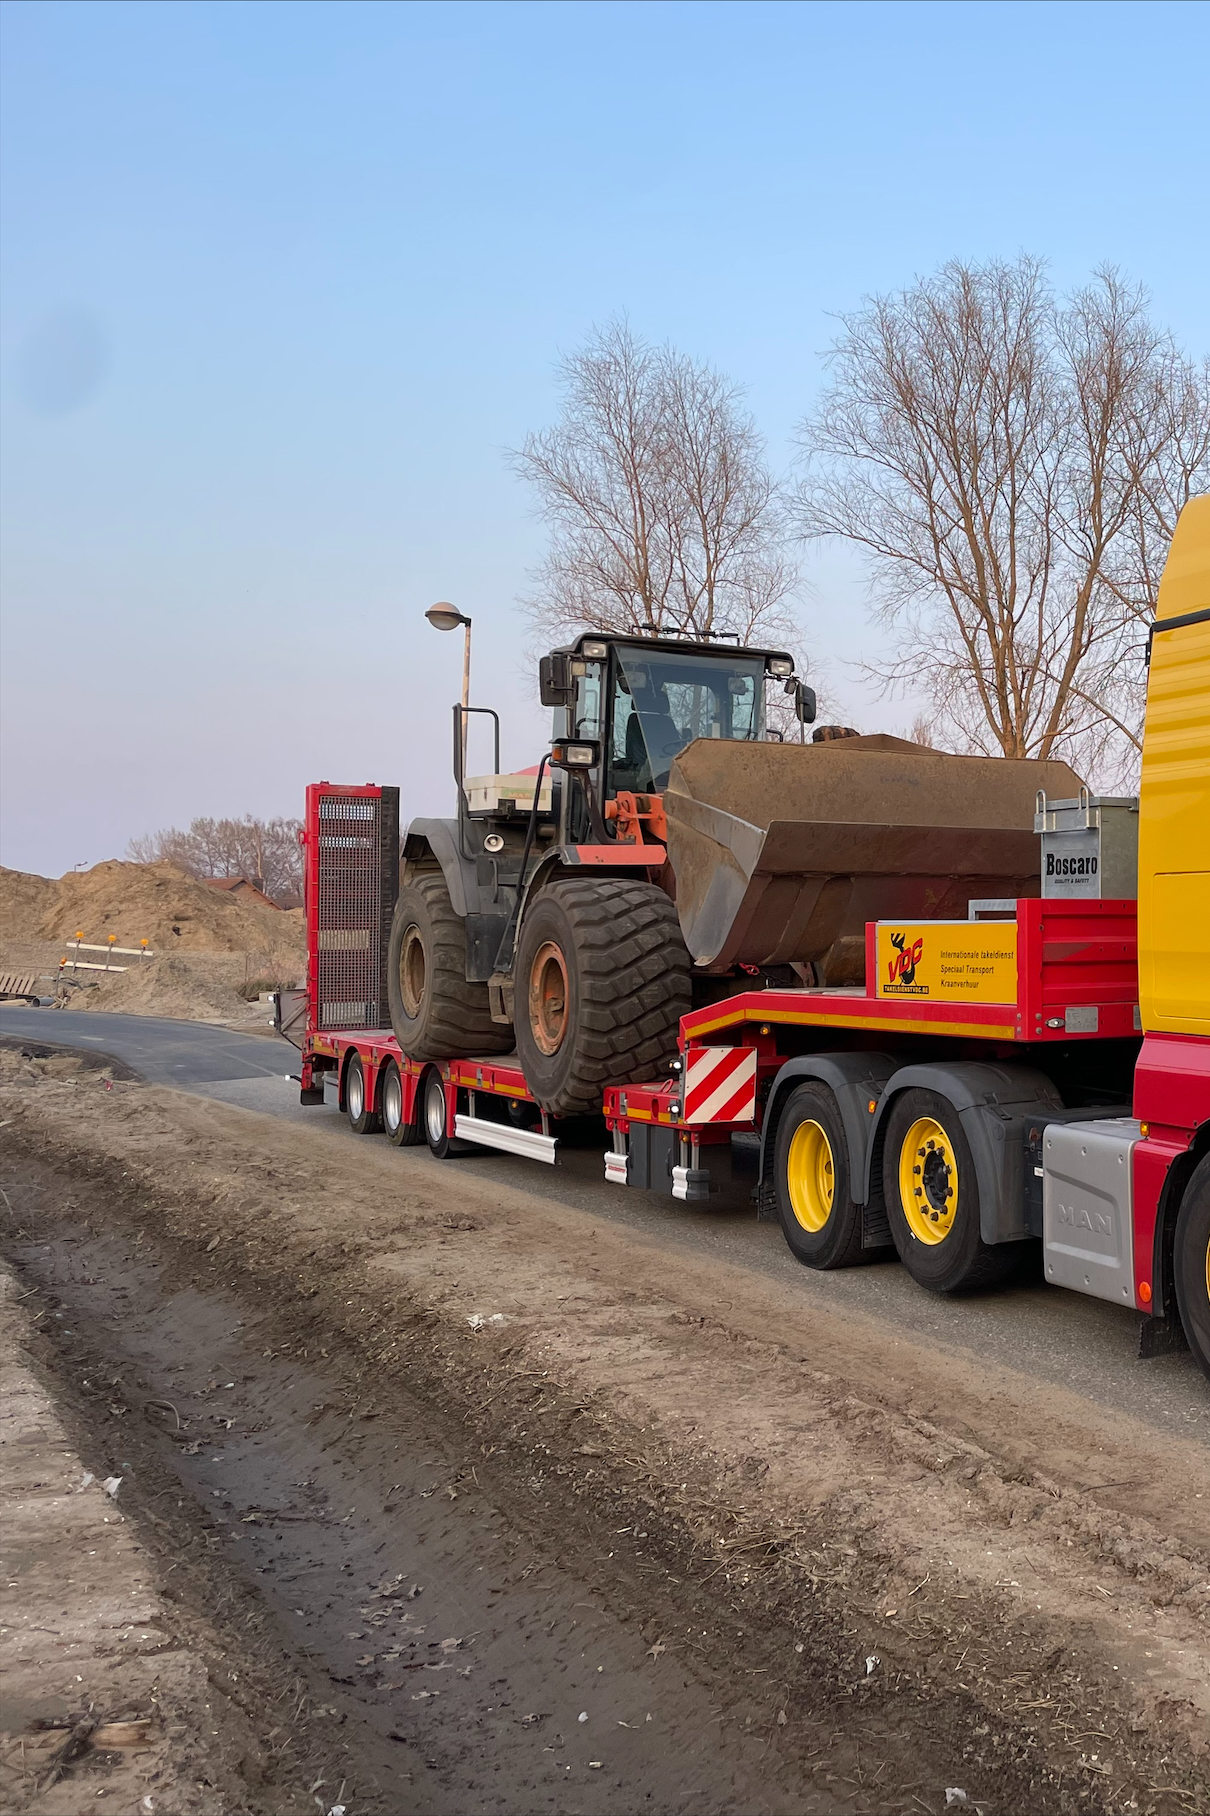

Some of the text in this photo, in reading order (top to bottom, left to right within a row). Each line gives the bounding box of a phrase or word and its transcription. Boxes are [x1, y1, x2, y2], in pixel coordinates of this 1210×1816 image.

[1046, 853, 1098, 876] Boscaro
[888, 937, 923, 983] VDC
[940, 950, 1014, 959] Internationale takeldienst
[940, 964, 994, 975] Speciaal Transport
[940, 979, 979, 988] Kraanverhuur
[1058, 1204, 1112, 1236] MAN
